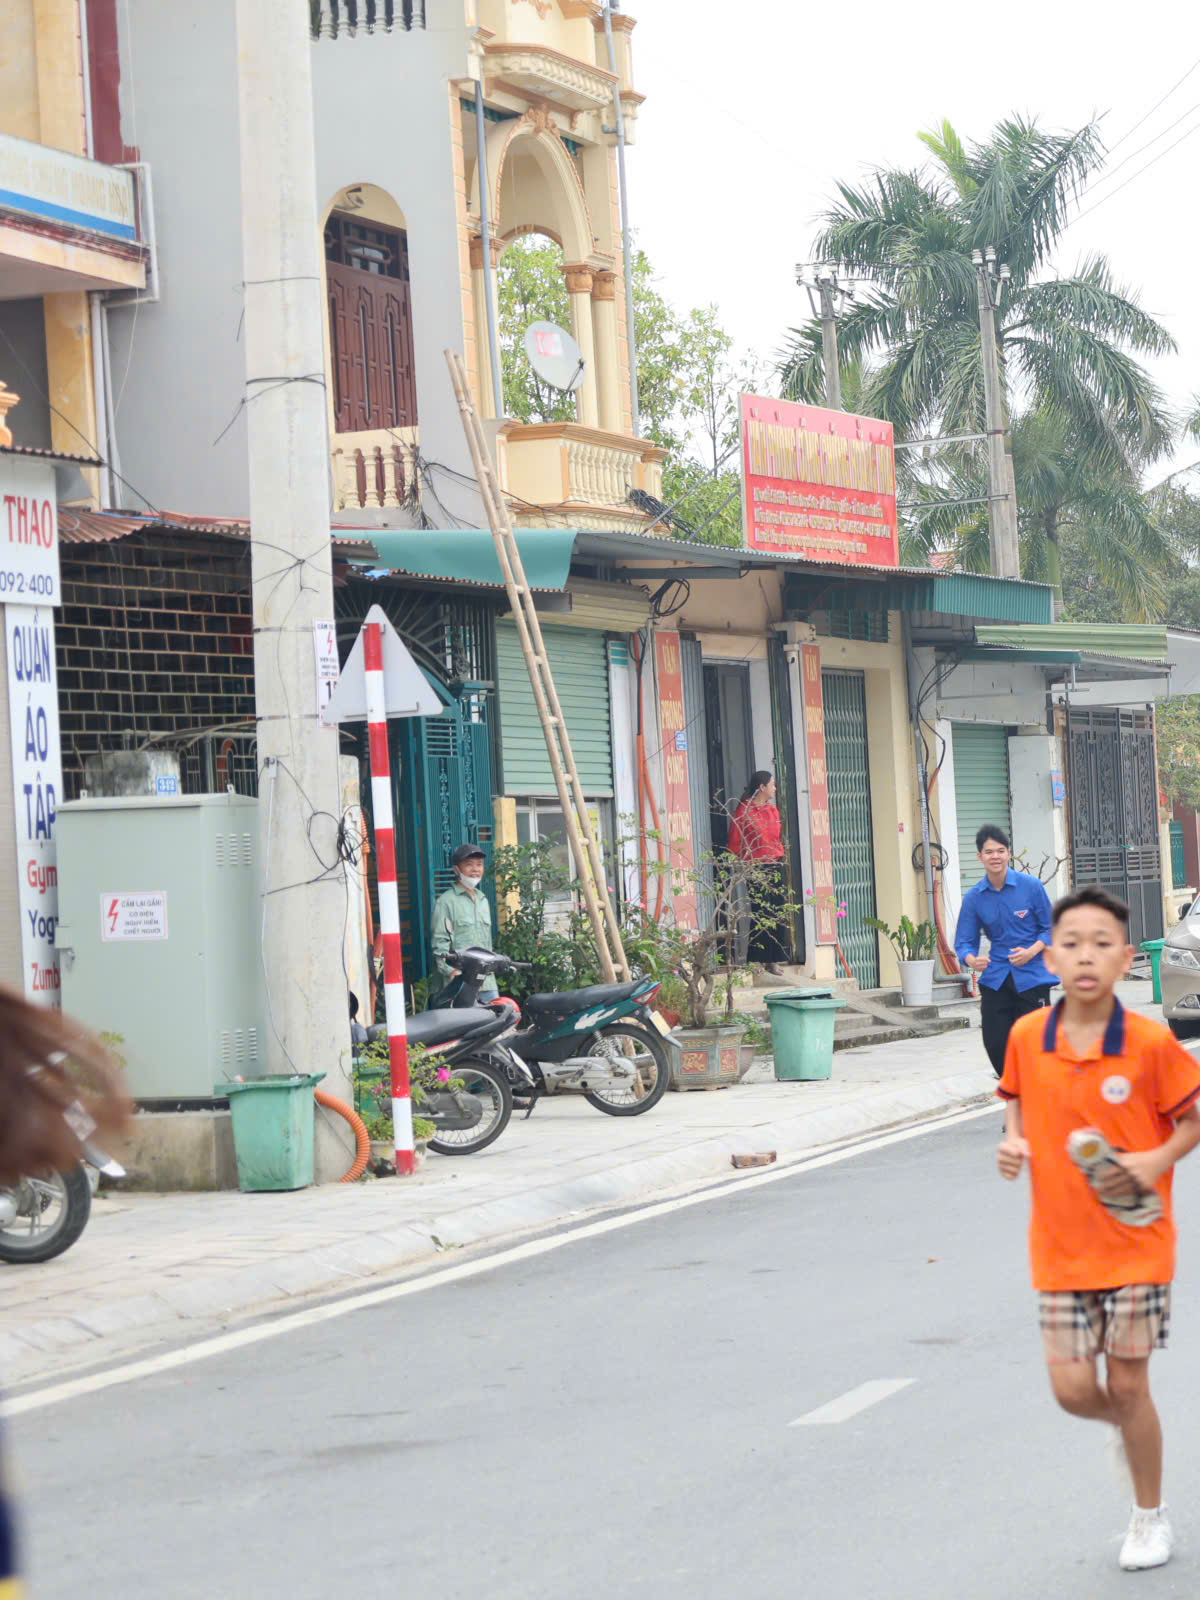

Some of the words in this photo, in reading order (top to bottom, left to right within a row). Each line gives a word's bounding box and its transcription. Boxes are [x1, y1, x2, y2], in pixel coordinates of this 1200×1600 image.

[4, 495, 53, 548] THAO
[13, 606, 51, 682] QUẦN
[25, 691, 48, 762] ÁO
[24, 771, 56, 848] TẬP
[27, 859, 58, 894] Gym
